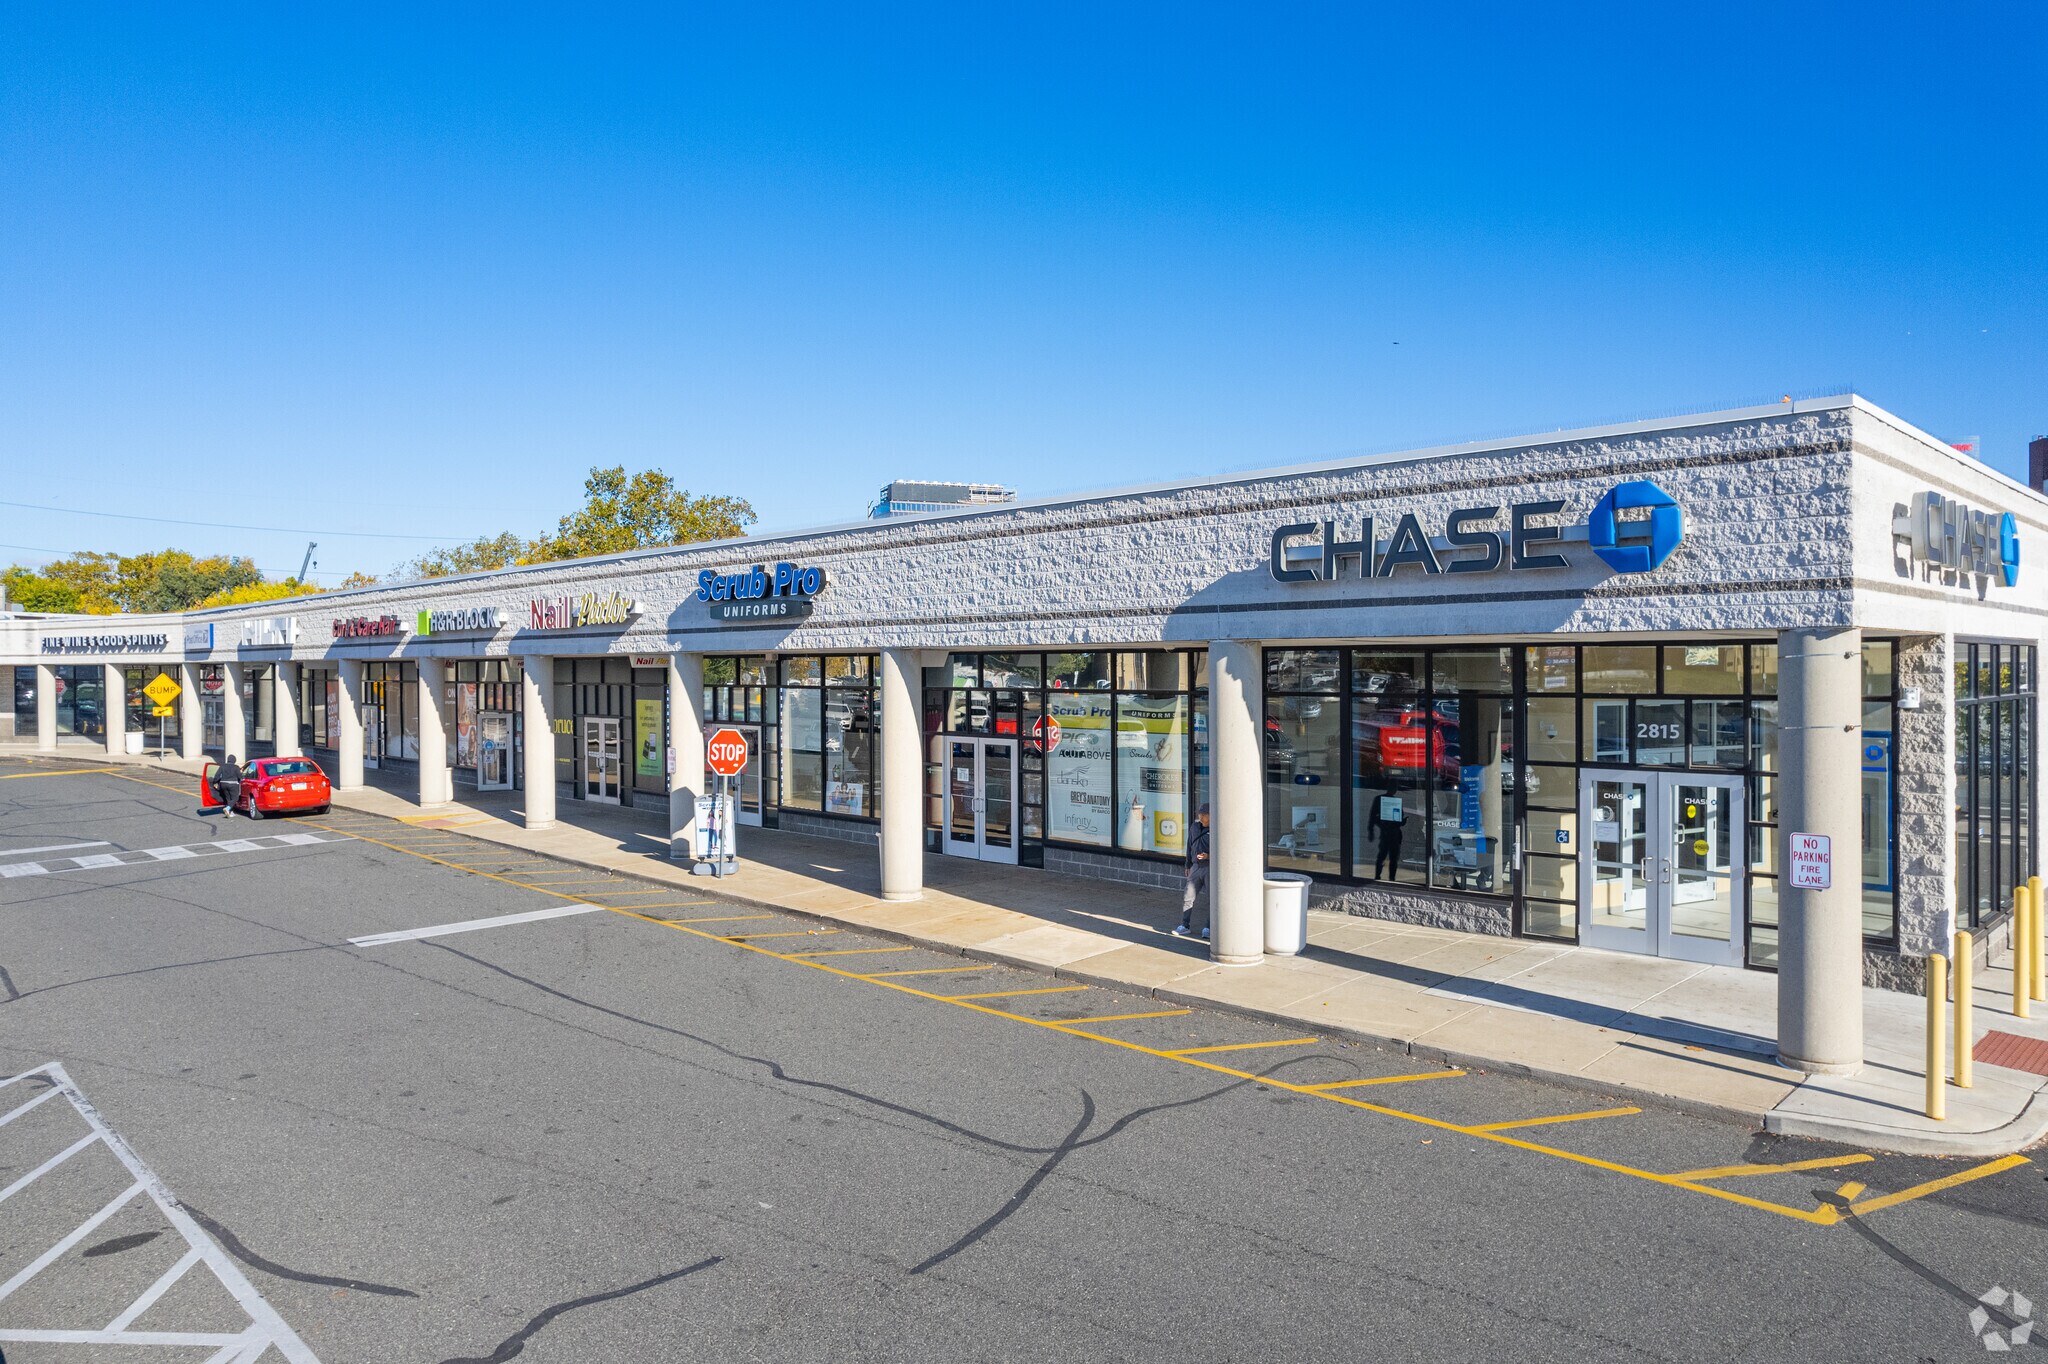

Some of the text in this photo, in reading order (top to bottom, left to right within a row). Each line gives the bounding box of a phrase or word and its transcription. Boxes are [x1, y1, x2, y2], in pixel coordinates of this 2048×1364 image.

[1270, 499, 1571, 583] CHASE
[1914, 491, 2000, 577] CHASE
[696, 561, 821, 602] Scrub Pro
[530, 591, 632, 630] Nail Parlor
[723, 603, 787, 618] UNIFORMS
[357, 616, 378, 637] Care
[378, 614, 397, 636] Hair
[430, 607, 498, 632] H&R BLOCK
[63, 636, 87, 647] WINE
[97, 635, 123, 647] GOOD
[126, 633, 165, 646] SPIRITS
[636, 657, 654, 665] Nail
[149, 686, 176, 694] BUMP
[1052, 705, 1112, 717] Scrub Pro
[1636, 723, 1680, 739] 2815
[710, 744, 745, 762] STOP
[1437, 820, 1460, 828] CHASE
[1803, 838, 1819, 850] NO
[1793, 850, 1829, 864] PARKING
[1800, 864, 1821, 874] FIRE
[1798, 874, 1823, 885] LANE
